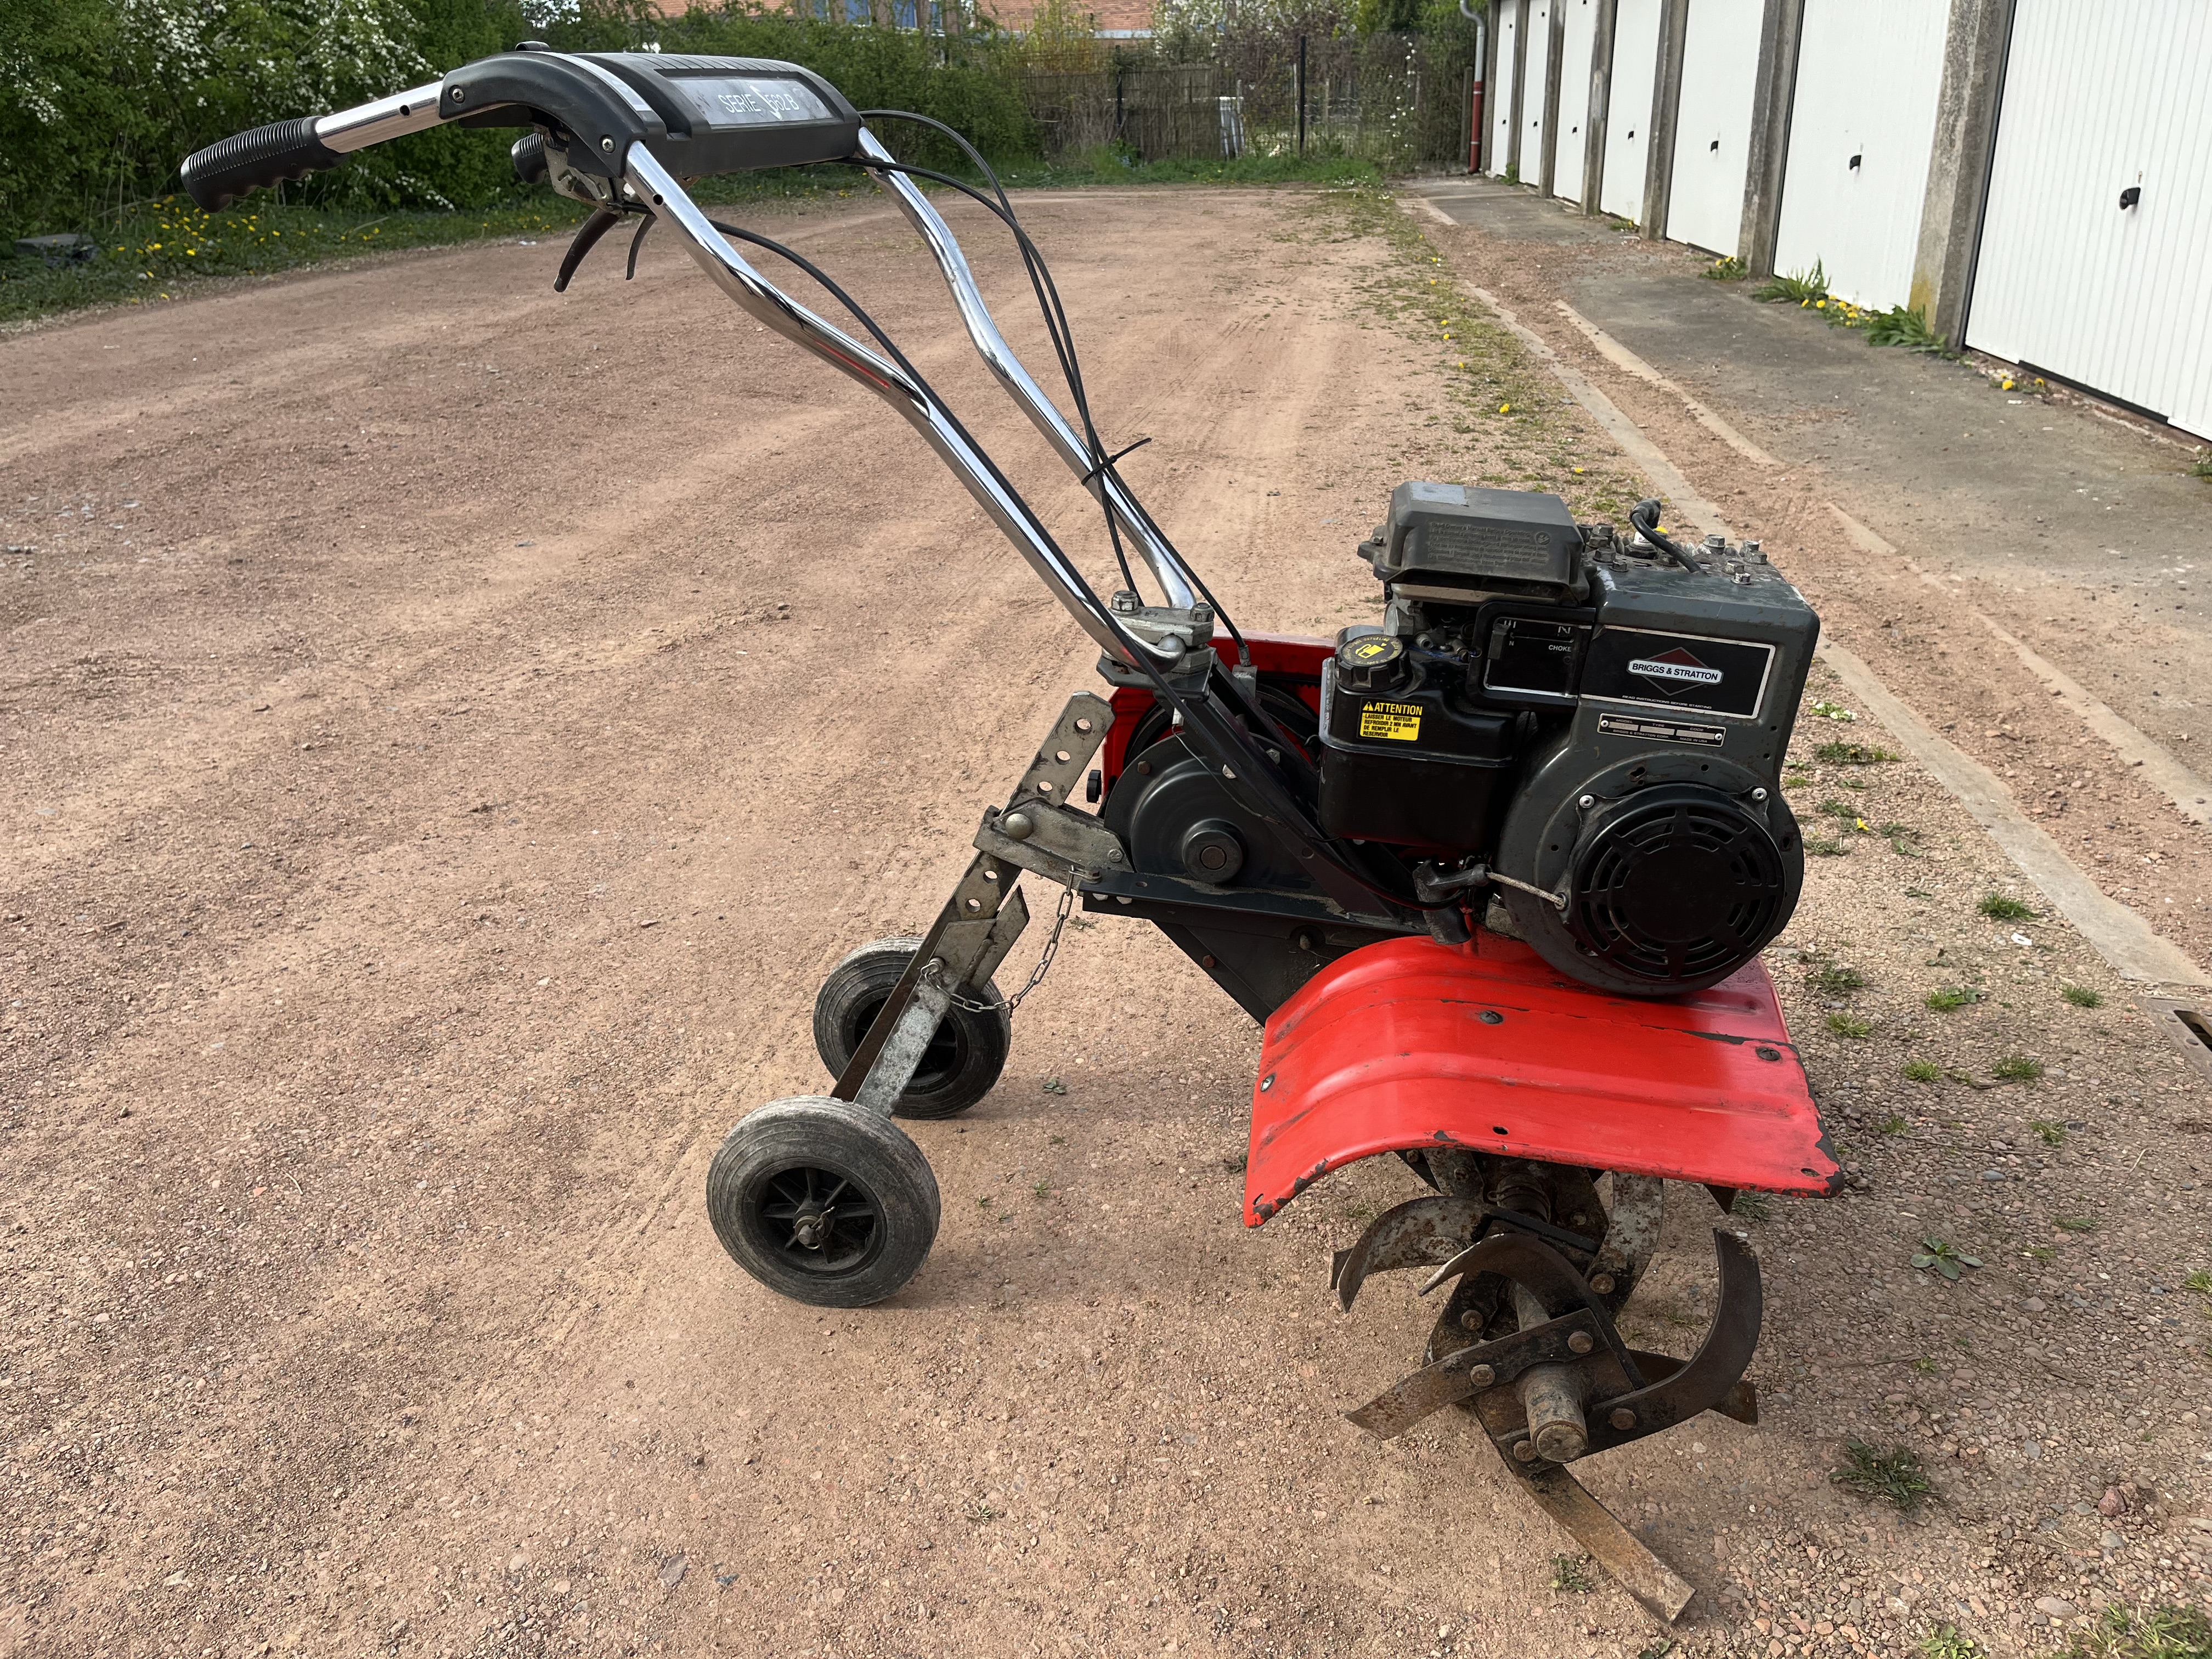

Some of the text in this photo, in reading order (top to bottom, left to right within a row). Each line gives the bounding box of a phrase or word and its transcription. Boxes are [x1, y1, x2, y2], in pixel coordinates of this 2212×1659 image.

[718, 93, 800, 114] SERIE 562 B
[1632, 663, 1665, 674] BRIGGS
[1673, 668, 1718, 680] STRATTON
[1374, 702, 1423, 715] ATTENTION
